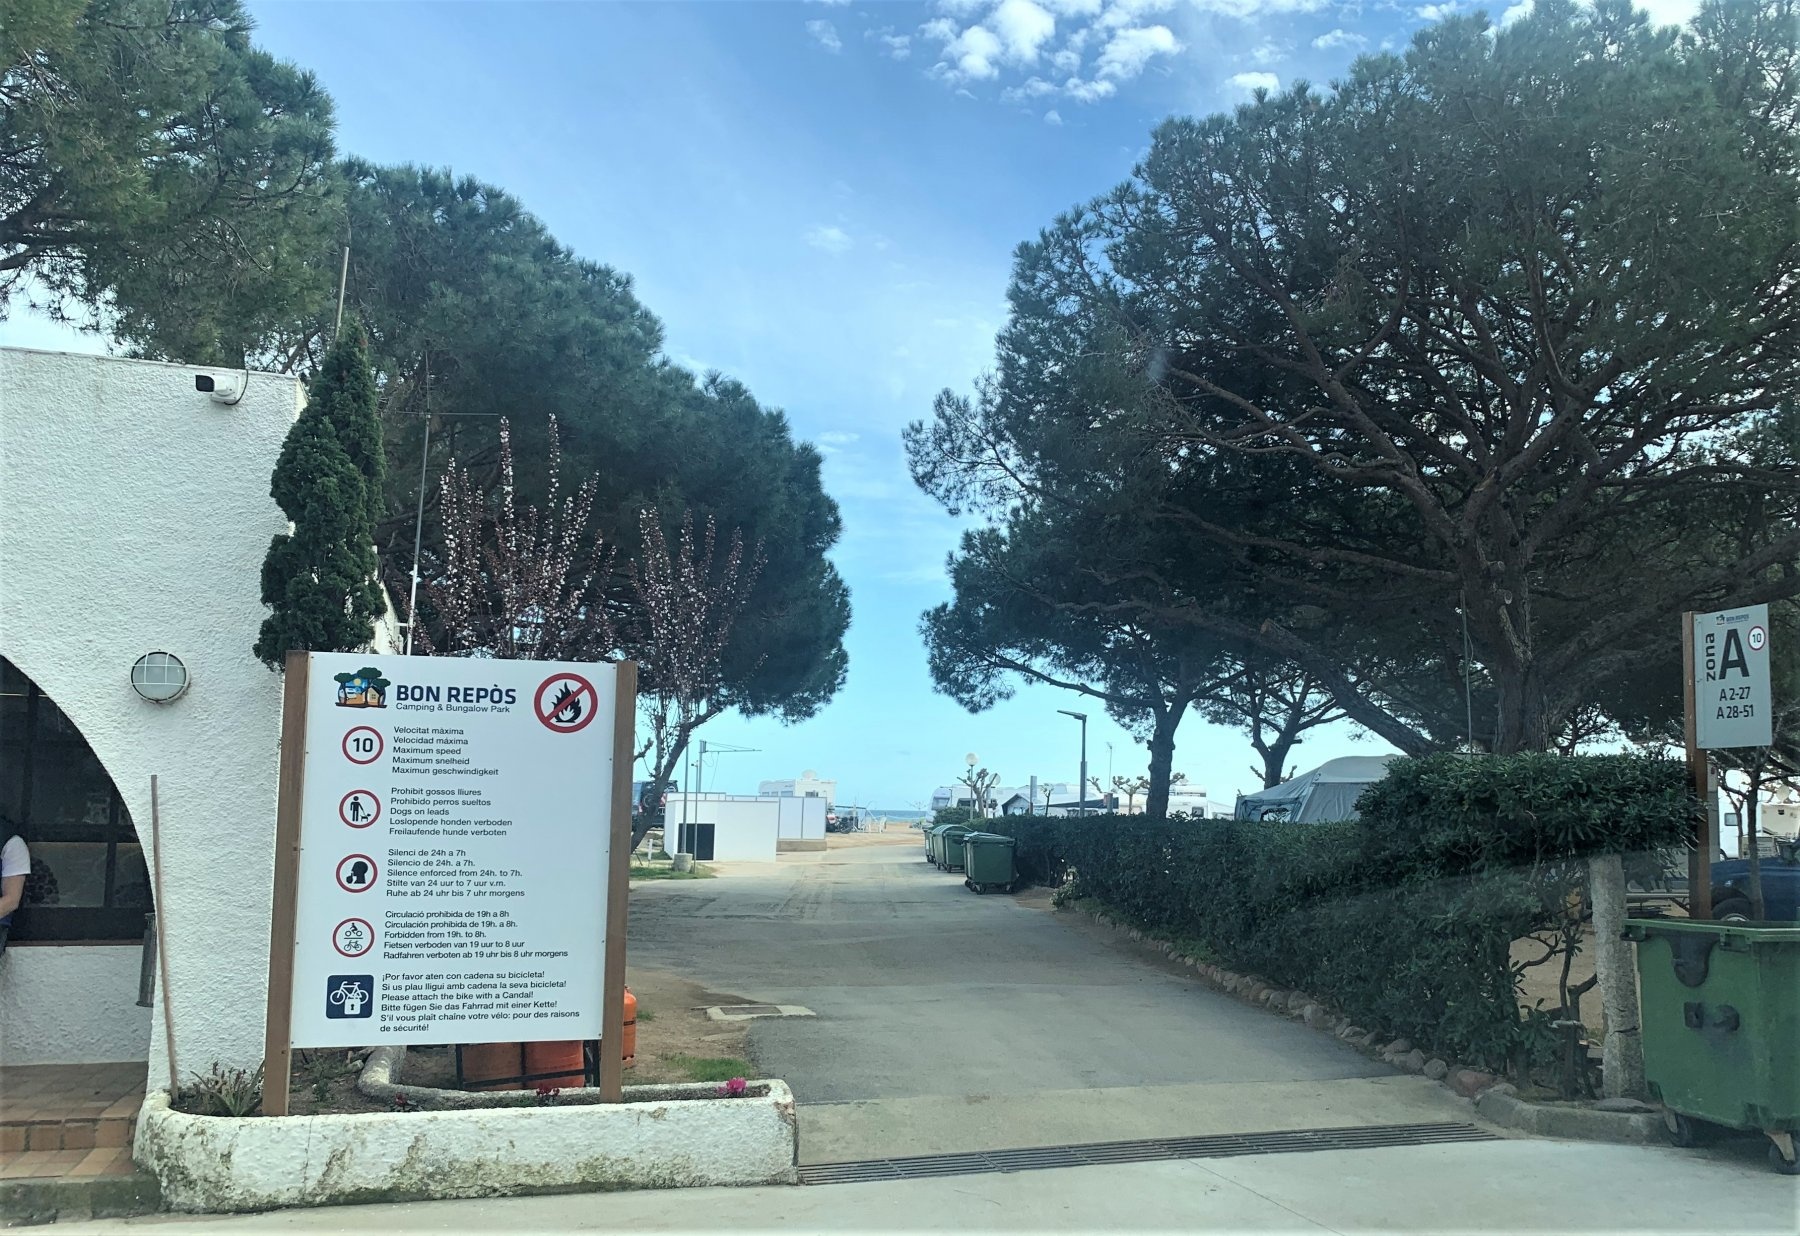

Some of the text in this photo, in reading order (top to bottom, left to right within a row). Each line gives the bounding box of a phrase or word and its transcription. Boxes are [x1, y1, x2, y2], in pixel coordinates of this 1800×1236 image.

[1752, 633, 1762, 644] 10
[1706, 629, 1750, 682] zona A
[396, 684, 516, 704] BON REPÒS
[1720, 686, 1750, 701] A 2-27
[395, 702, 435, 712] Camping
[445, 703, 488, 713] Bungalow
[1716, 704, 1754, 719] A 28-51
[352, 738, 374, 752] 10
[432, 768, 498, 776] geschwindigkeit
[390, 807, 412, 816] Dogs
[404, 983, 422, 991] plau
[424, 982, 444, 991] lligui
